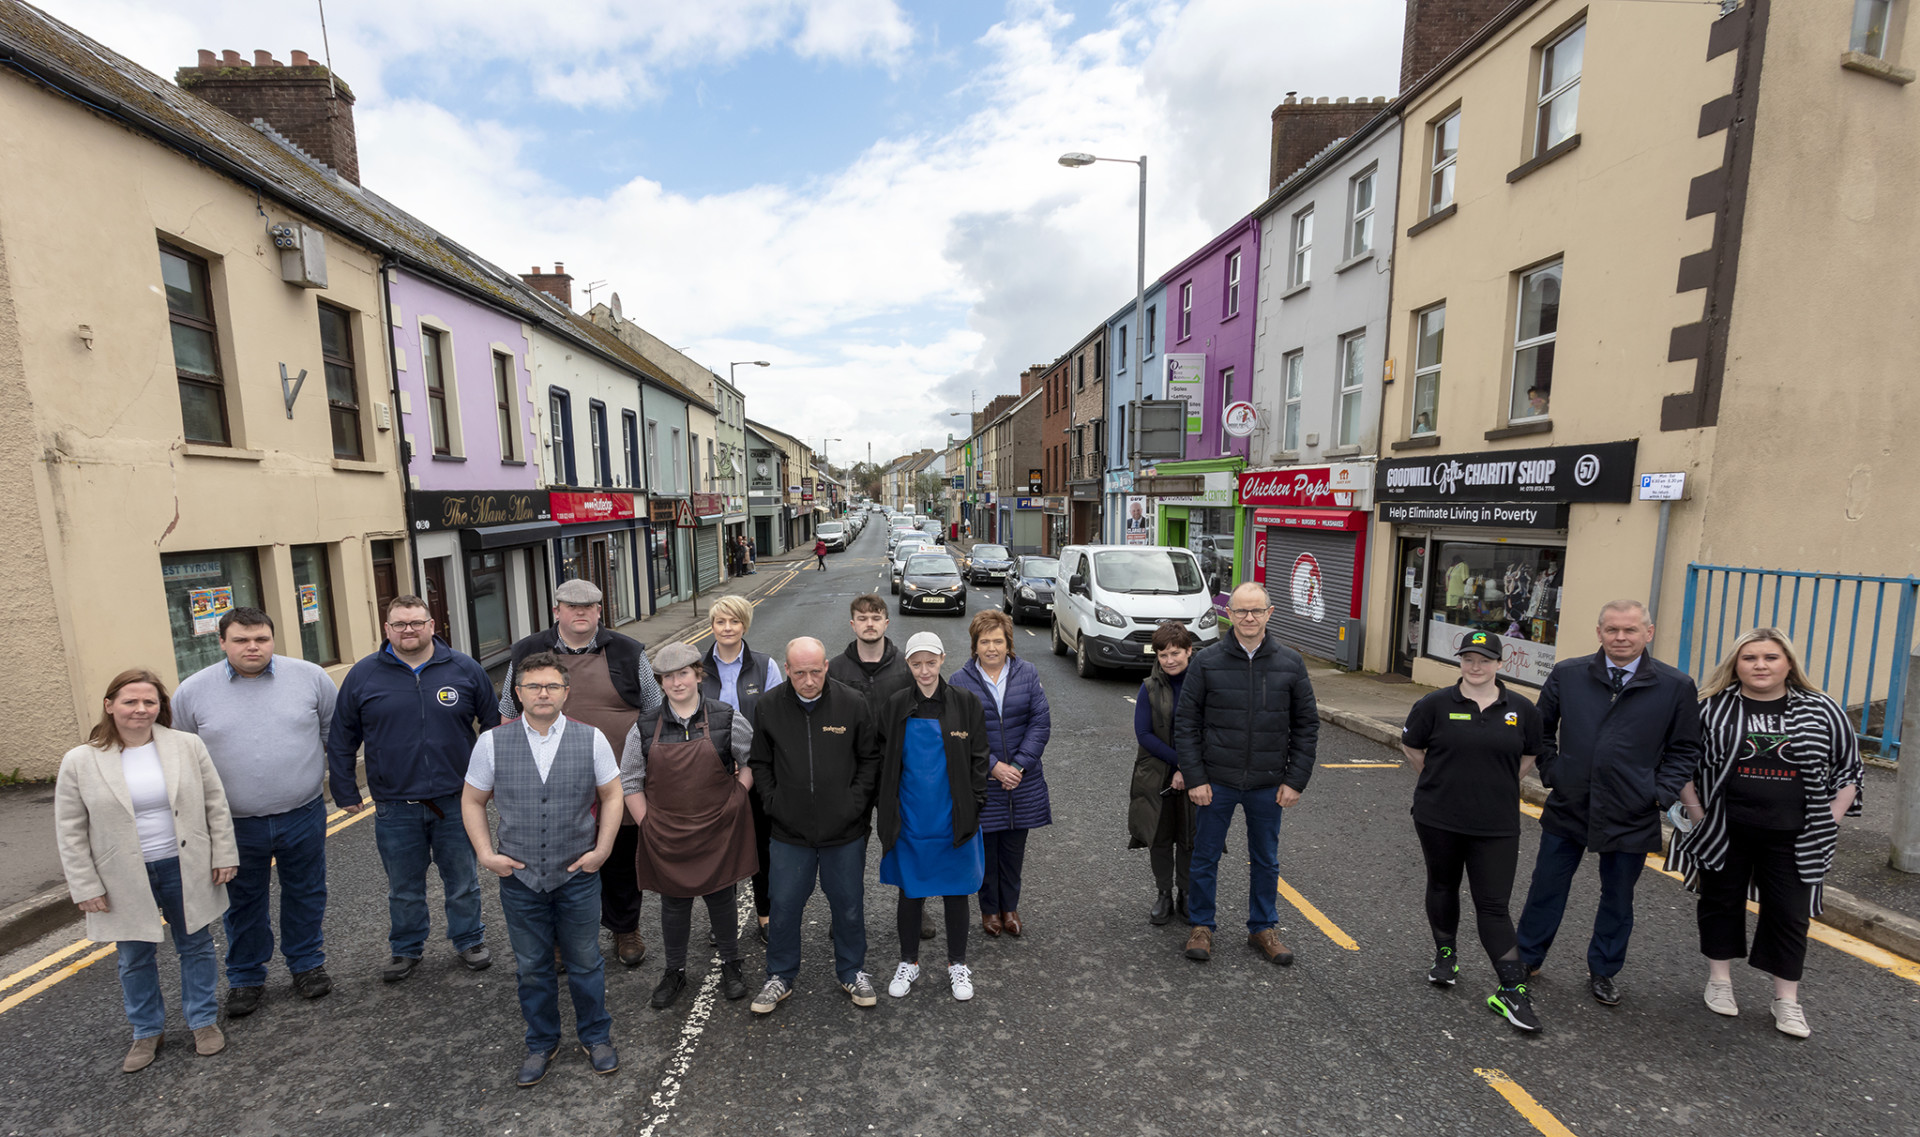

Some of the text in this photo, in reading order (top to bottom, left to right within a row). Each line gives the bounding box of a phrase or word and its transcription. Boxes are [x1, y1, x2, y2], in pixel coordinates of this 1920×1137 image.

[1386, 460, 1556, 494] GOODWILL Gifts CHARITY SHOP
[1580, 461, 1595, 480] 57
[1242, 474, 1332, 502] Chicken Pops
[442, 494, 534, 527] The Mane Men
[1389, 506, 1538, 524] Help Eliminate Living in Poverty
[162, 566, 180, 576] EST
[183, 562, 220, 574] TYRONE
[1538, 651, 1556, 660] SUPPOR
[1534, 660, 1554, 670] HOMELE
